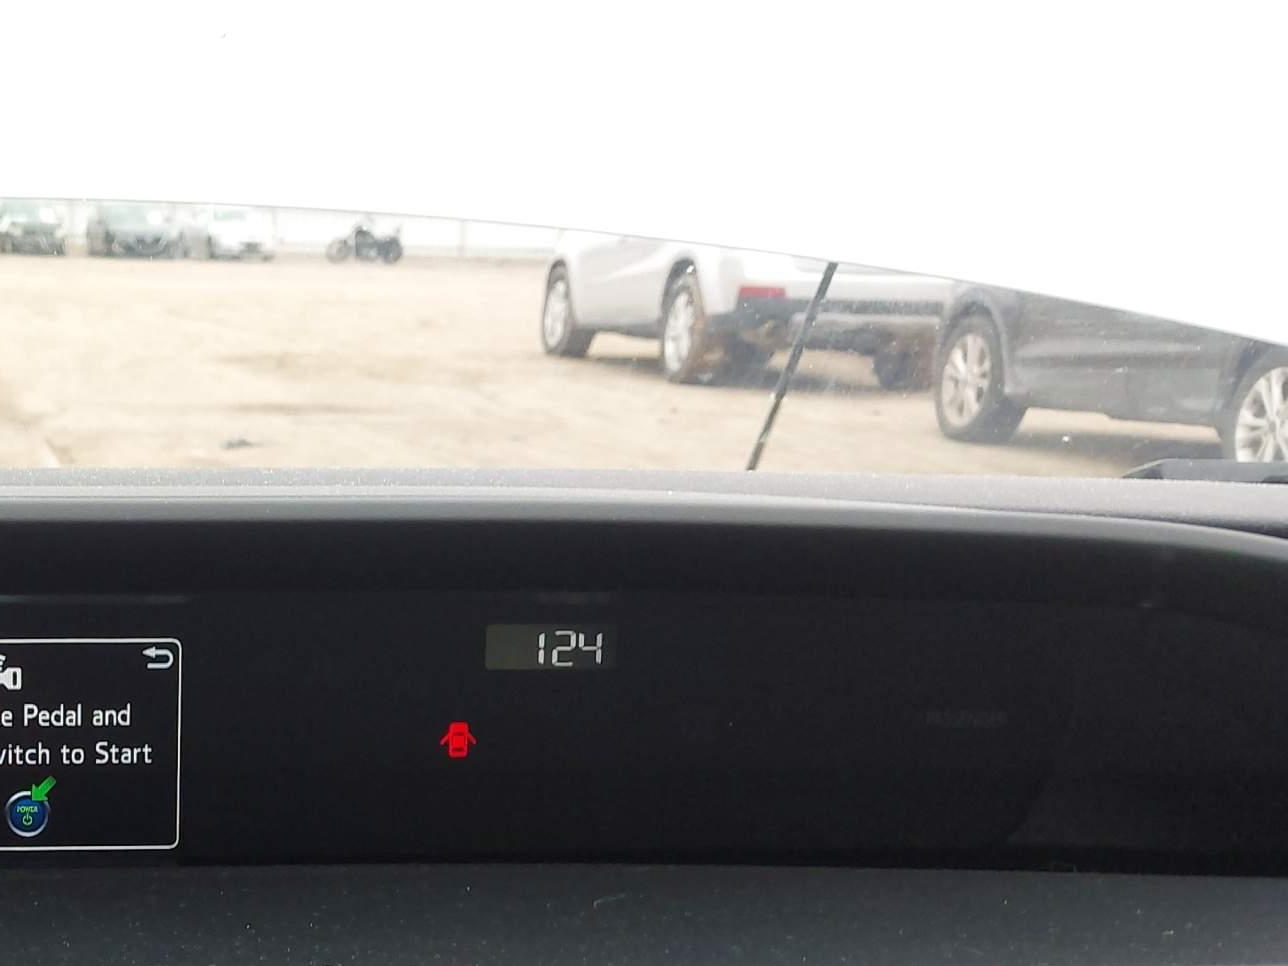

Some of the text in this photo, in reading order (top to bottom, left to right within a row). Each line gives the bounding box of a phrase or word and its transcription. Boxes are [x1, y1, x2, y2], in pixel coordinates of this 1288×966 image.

[538, 630, 604, 667] 124
[23, 703, 82, 727] Pedal
[92, 702, 131, 727] and
[60, 744, 85, 765] to
[95, 741, 152, 765] Start
